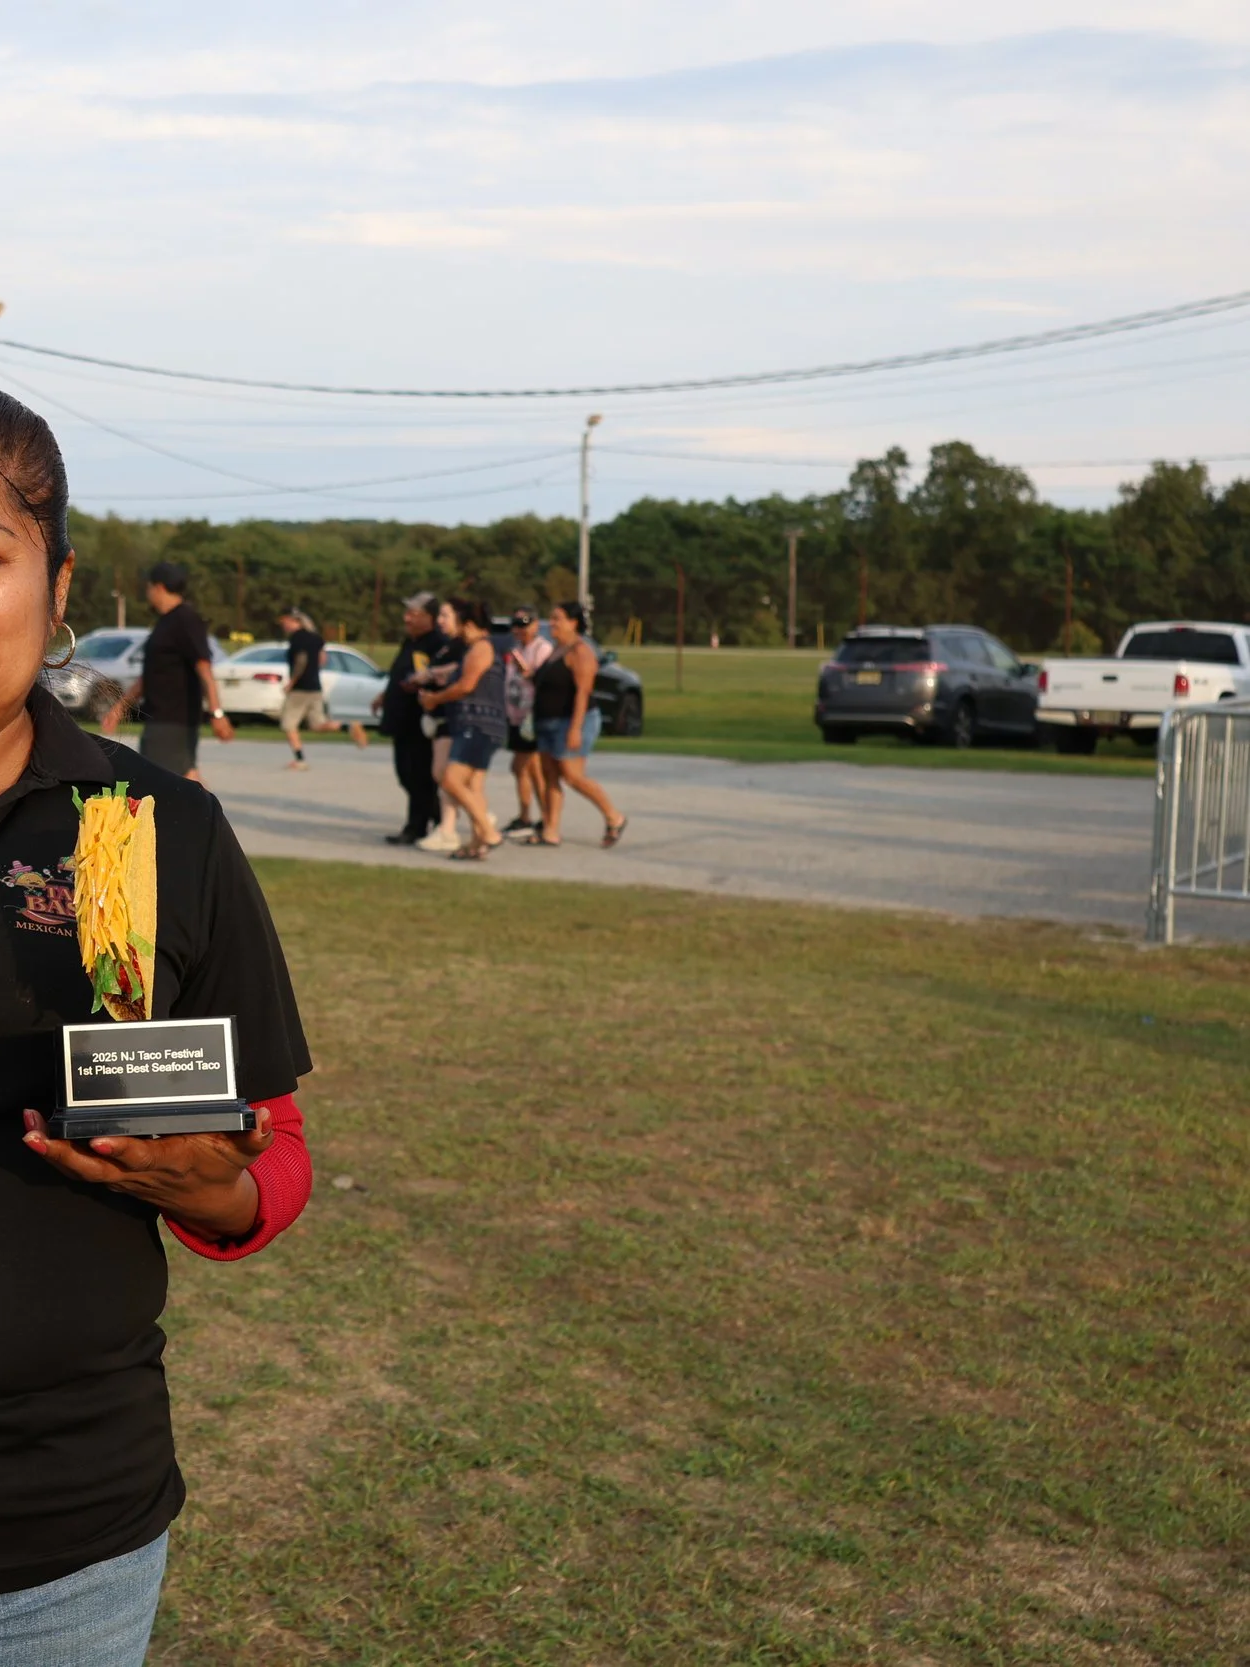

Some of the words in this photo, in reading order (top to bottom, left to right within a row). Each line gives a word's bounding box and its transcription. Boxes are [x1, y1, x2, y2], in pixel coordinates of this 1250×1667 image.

[15, 920, 73, 938] MEXICAN
[92, 1052, 118, 1063] 2025
[120, 1051, 135, 1062] NJ
[137, 1050, 162, 1061] Taco
[164, 1048, 204, 1060] Festival
[77, 1066, 93, 1076] 1st
[95, 1065, 124, 1075] Place
[126, 1063, 150, 1074] Best
[151, 1061, 194, 1073] Seafood
[195, 1060, 221, 1071] Taco
